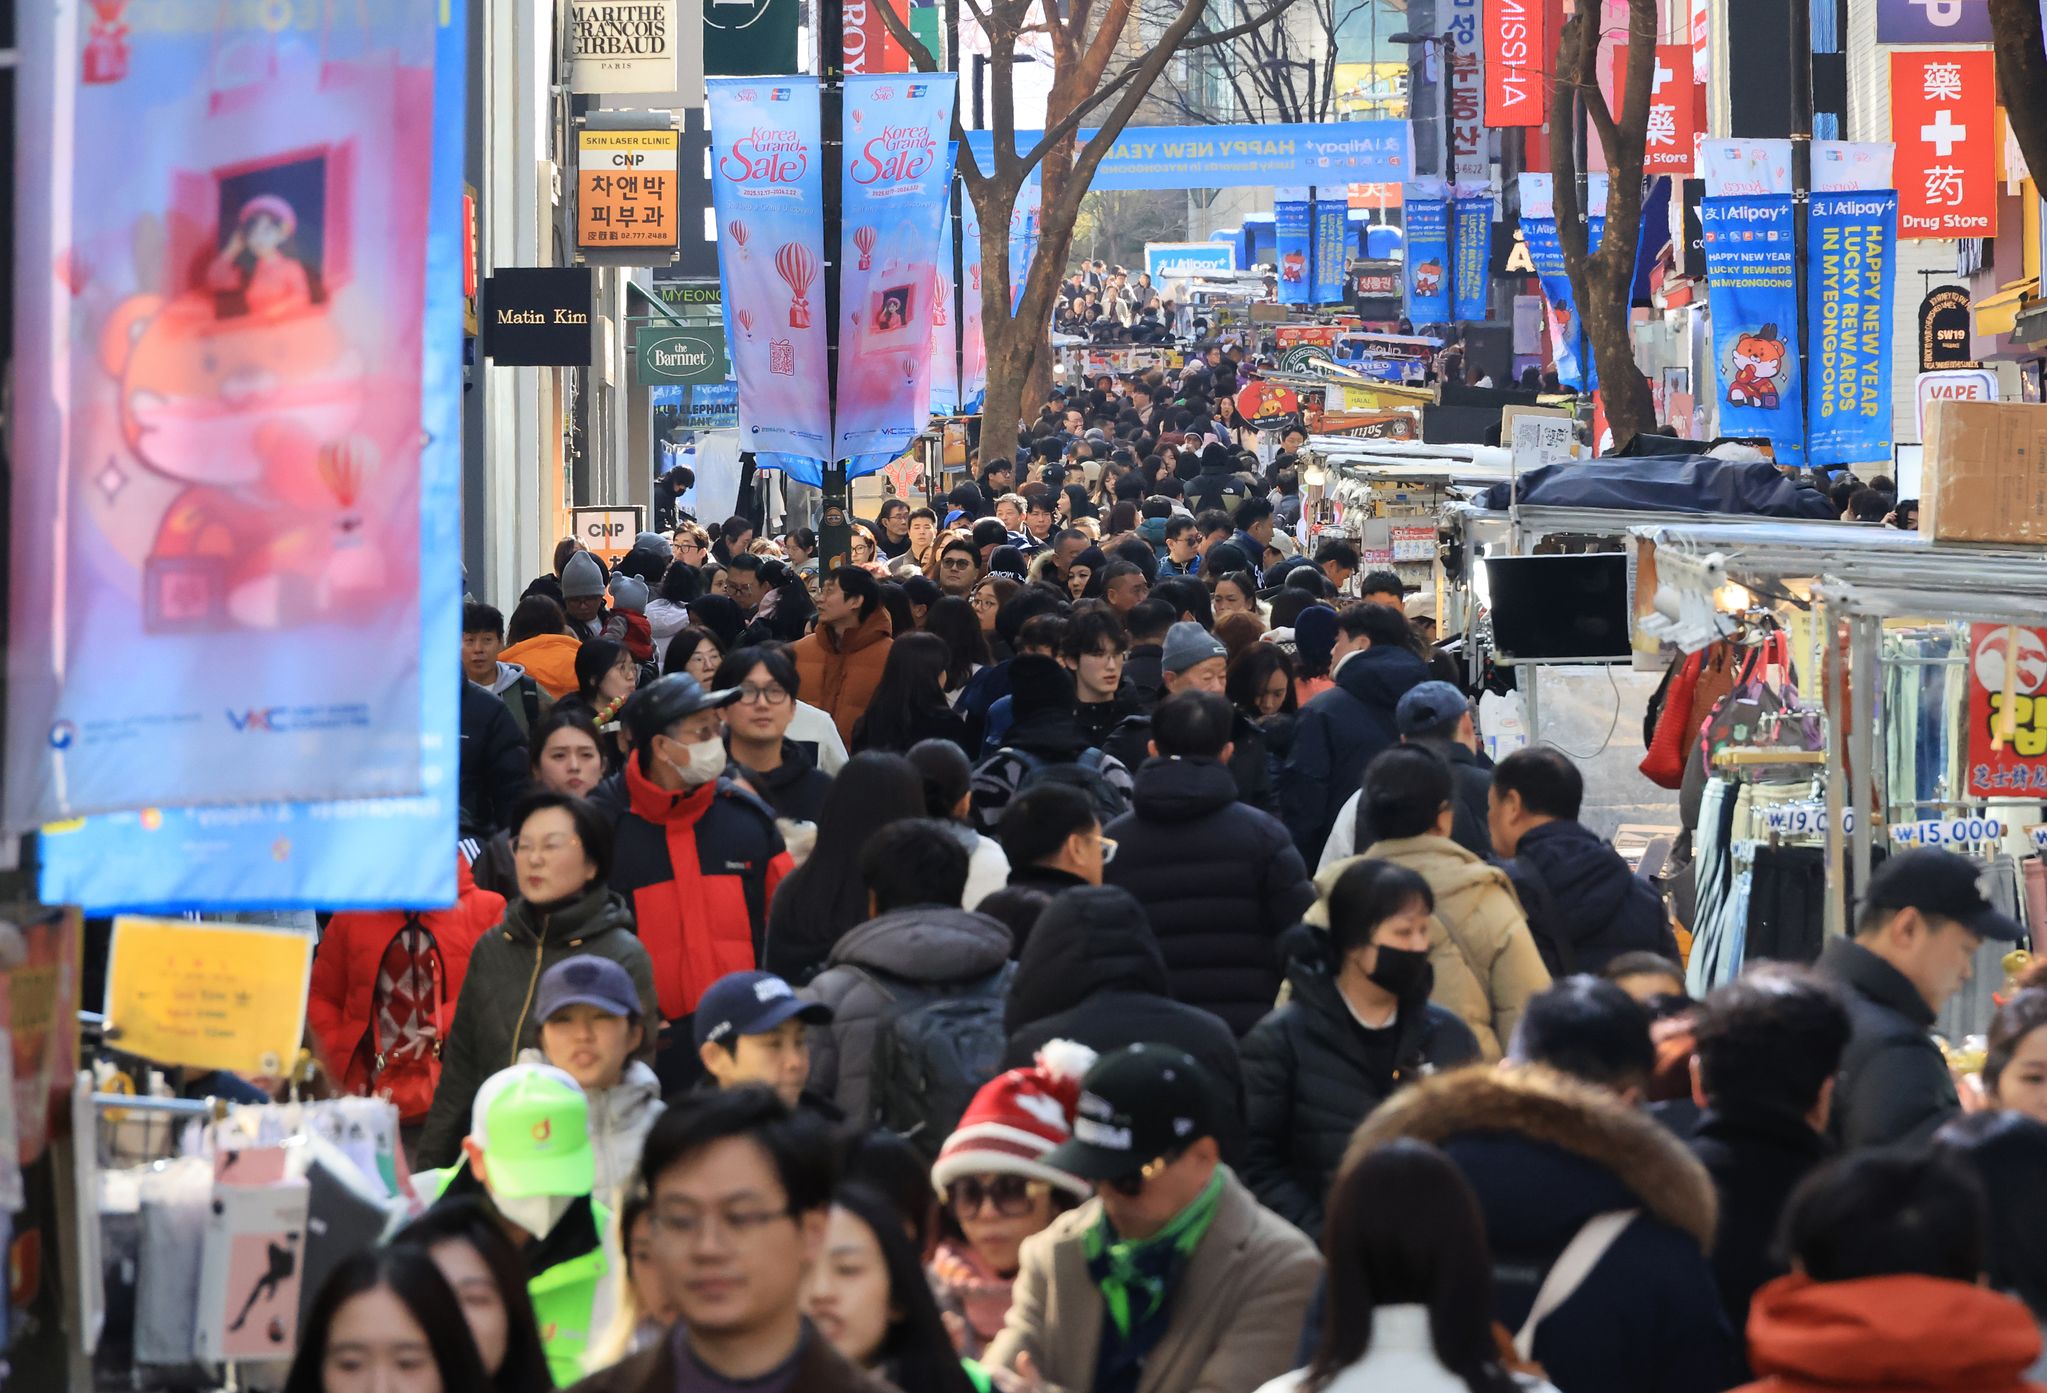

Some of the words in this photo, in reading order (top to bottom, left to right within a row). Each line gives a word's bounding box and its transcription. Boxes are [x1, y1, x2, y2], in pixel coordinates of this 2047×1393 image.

[1924, 62, 1962, 101] 藥
[586, 137, 607, 145] SKIN
[610, 137, 639, 145] LASER
[642, 137, 671, 145] CLINIC
[752, 127, 796, 141] Korea
[883, 125, 928, 141] Korea
[754, 139, 800, 153] Grand
[885, 134, 930, 151] Grand
[612, 154, 644, 166] CNP
[720, 137, 807, 182] Sale
[851, 140, 937, 184] Sale
[1653, 153, 1688, 164] Store
[591, 175, 665, 201] 차앤박
[1924, 165, 1964, 205] 药
[591, 205, 664, 228] 피부과
[1902, 215, 1939, 230] Drug
[1944, 214, 1988, 228] Store
[1824, 228, 1839, 250] IN
[1709, 253, 1739, 261] HAPPY
[1741, 252, 1763, 261] NEW
[1766, 252, 1791, 261] YEAR
[1843, 226, 1861, 298] LUCKY
[1864, 226, 1882, 300] HAPPY
[1710, 266, 1739, 274] LUCKY
[1743, 266, 1792, 274] REWARDS
[1711, 279, 1721, 288] IN
[1722, 279, 1792, 288] MYEONGDONG
[498, 309, 546, 324] Matin
[553, 309, 587, 324] Kim
[1821, 255, 1839, 416] MYEONGDONG
[1862, 304, 1880, 355] NEW
[1937, 330, 1965, 340] SW19
[674, 343, 687, 352] the
[655, 350, 706, 366] Barnnet
[1839, 303, 1859, 411] REWARDS
[1861, 357, 1878, 416] YEAR
[1930, 385, 1978, 399] VAPE
[588, 523, 625, 538] CNP
